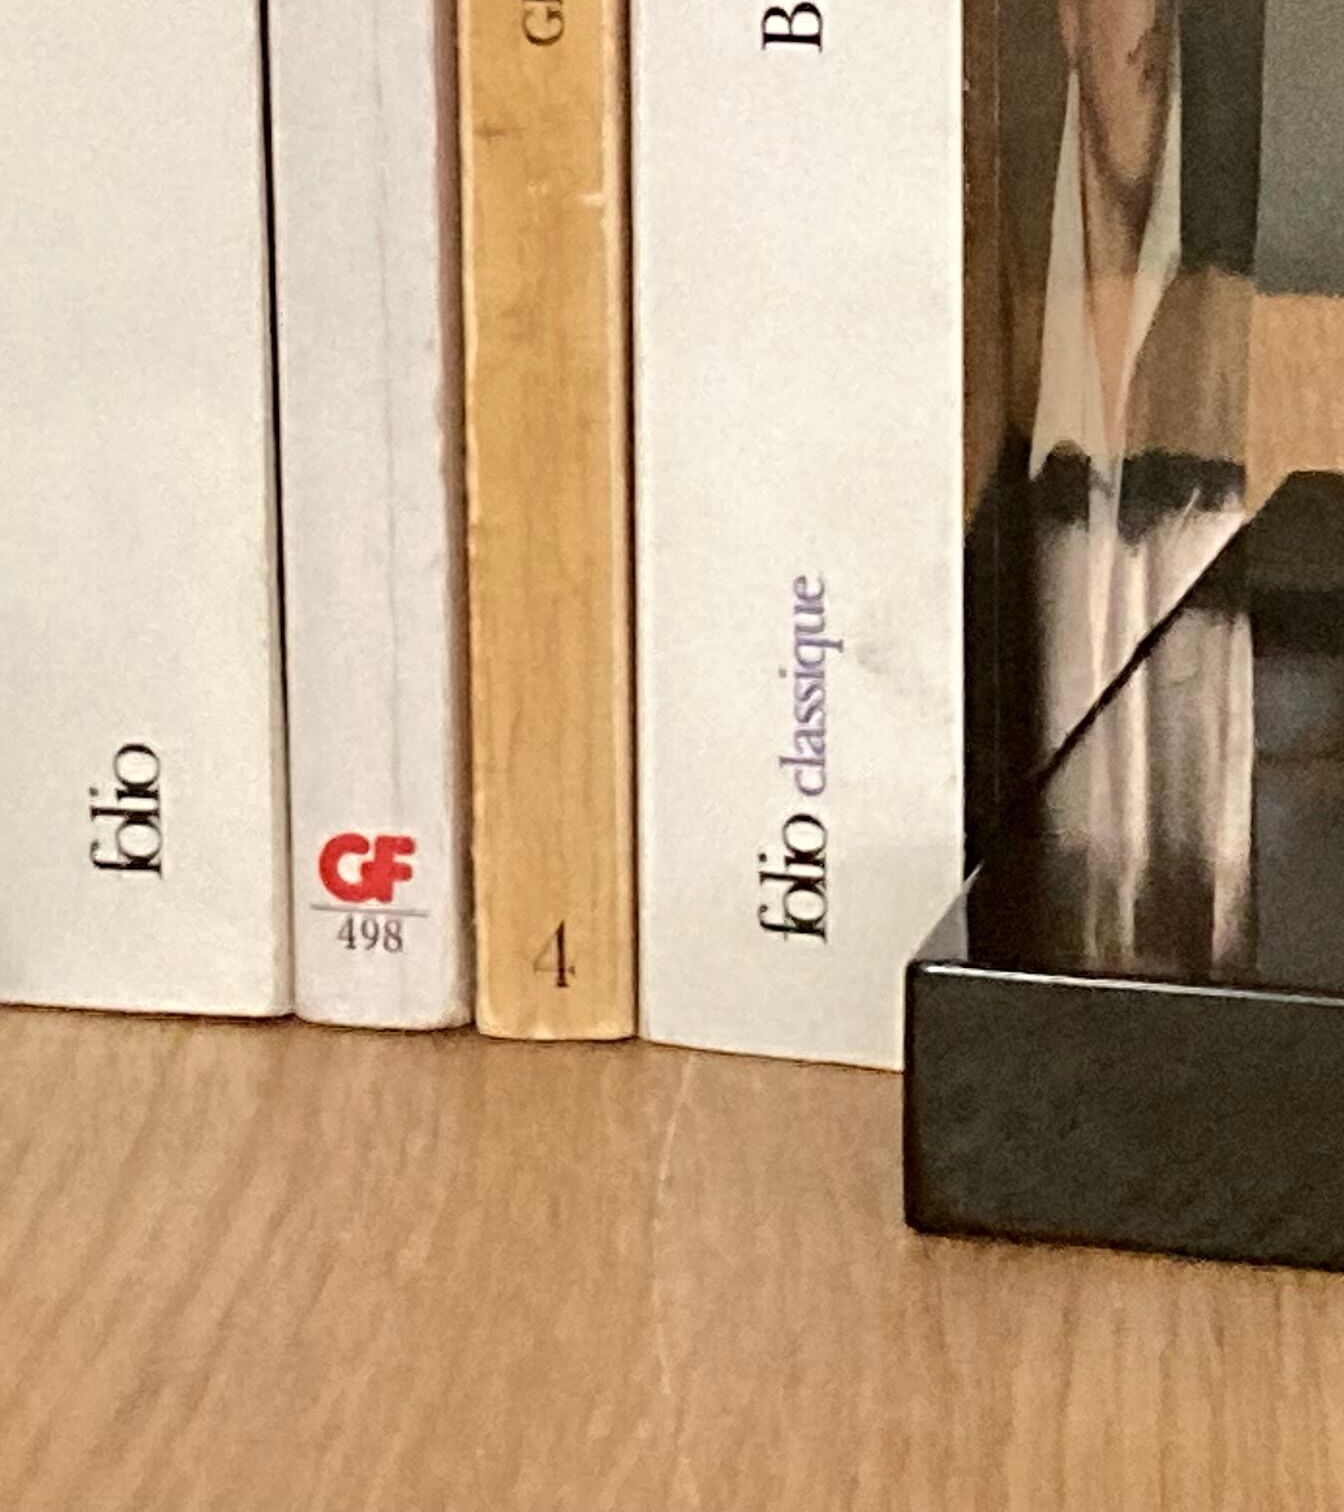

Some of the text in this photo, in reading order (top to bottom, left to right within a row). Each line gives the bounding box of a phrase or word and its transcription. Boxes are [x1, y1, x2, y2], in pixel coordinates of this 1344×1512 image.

[758, 574, 846, 944] folio classique
[89, 742, 163, 879] folio
[318, 832, 417, 904] GF
[336, 913, 406, 955] 498
[532, 919, 577, 990] 4
